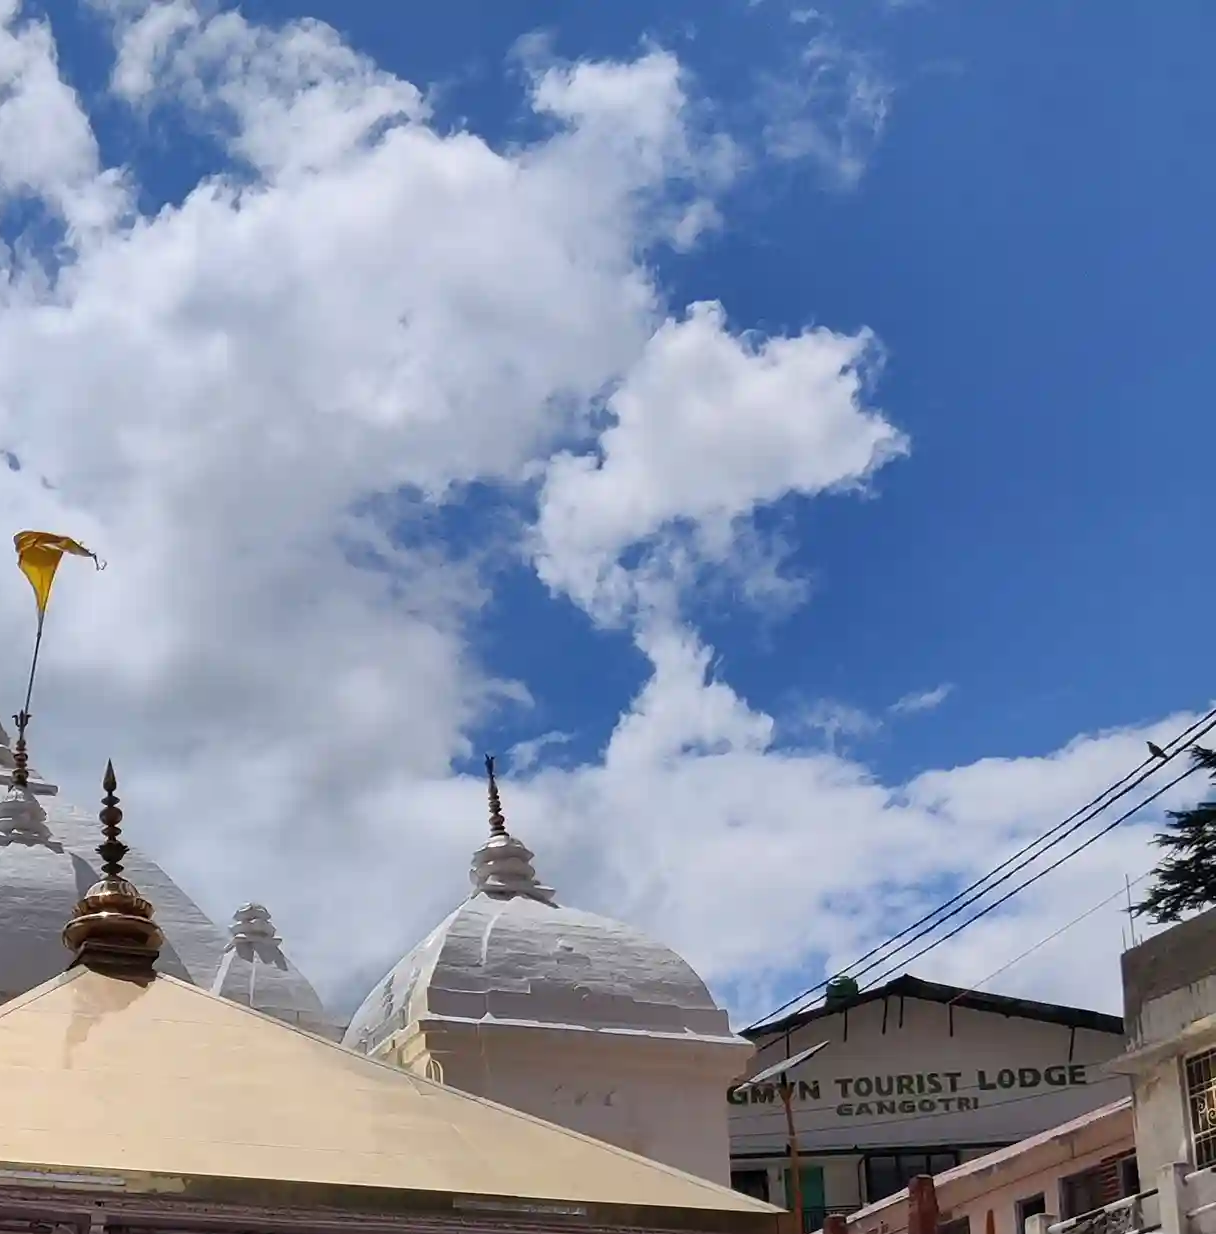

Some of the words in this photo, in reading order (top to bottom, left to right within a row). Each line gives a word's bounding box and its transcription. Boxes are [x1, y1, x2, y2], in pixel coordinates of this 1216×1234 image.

[834, 1072, 963, 1098] TOURIST
[977, 1065, 1088, 1091] LODGE
[836, 1096, 980, 1117] GANGOTRI
